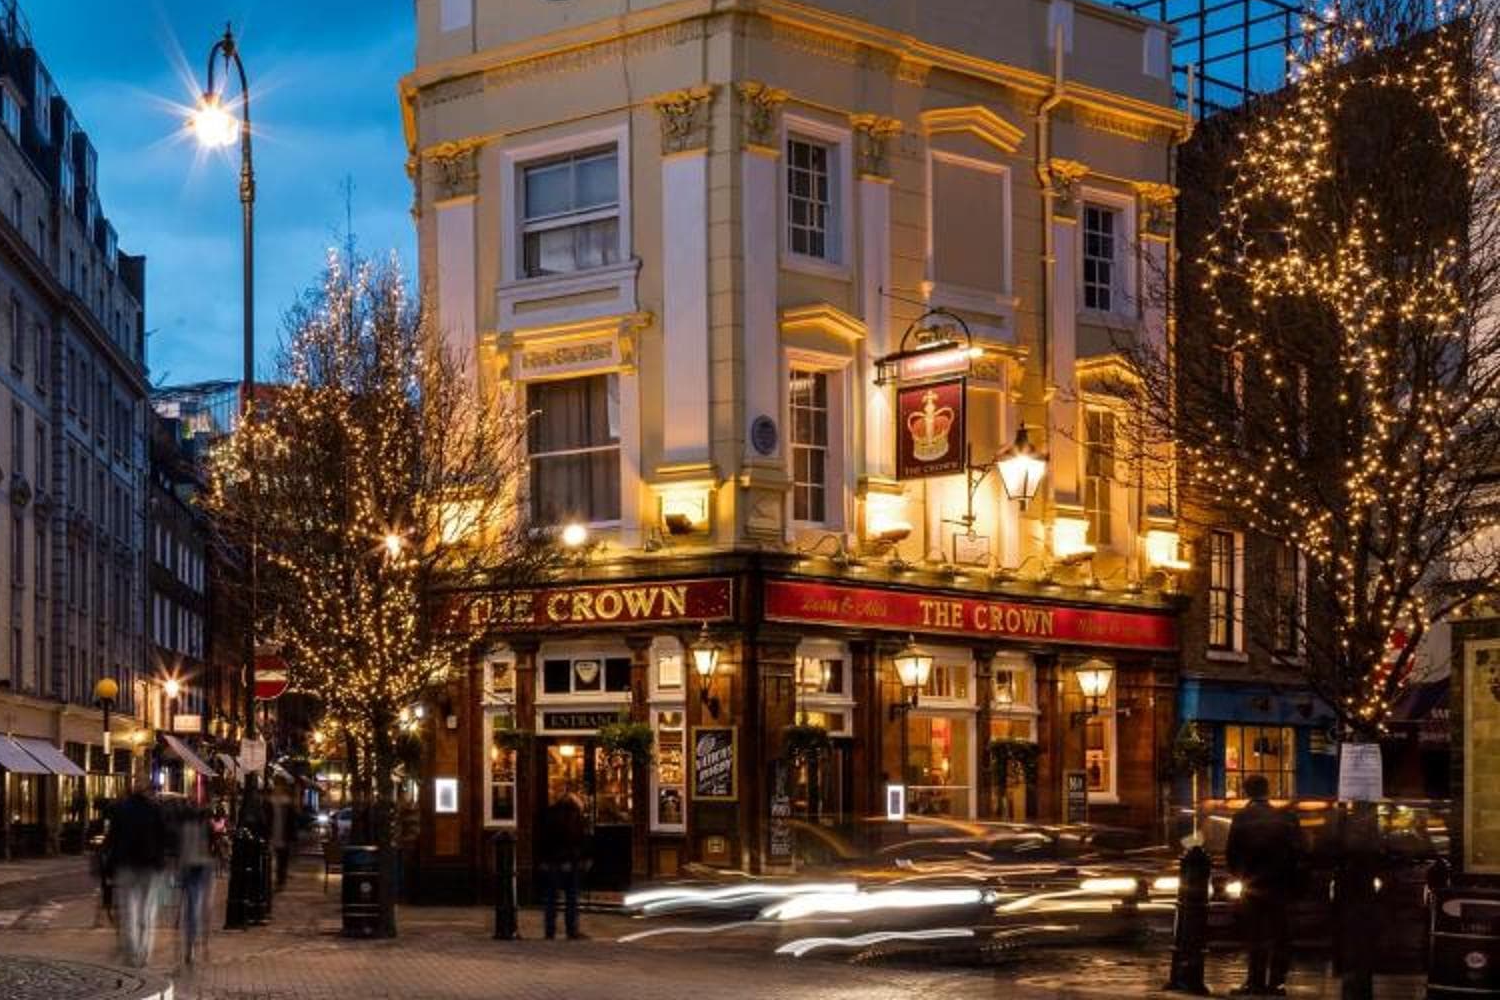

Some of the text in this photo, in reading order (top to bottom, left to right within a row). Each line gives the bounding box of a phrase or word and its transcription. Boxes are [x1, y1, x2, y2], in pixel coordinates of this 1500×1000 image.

[470, 586, 688, 625] THE CROWN
[919, 600, 964, 628] THE
[974, 603, 1055, 636] CROWN
